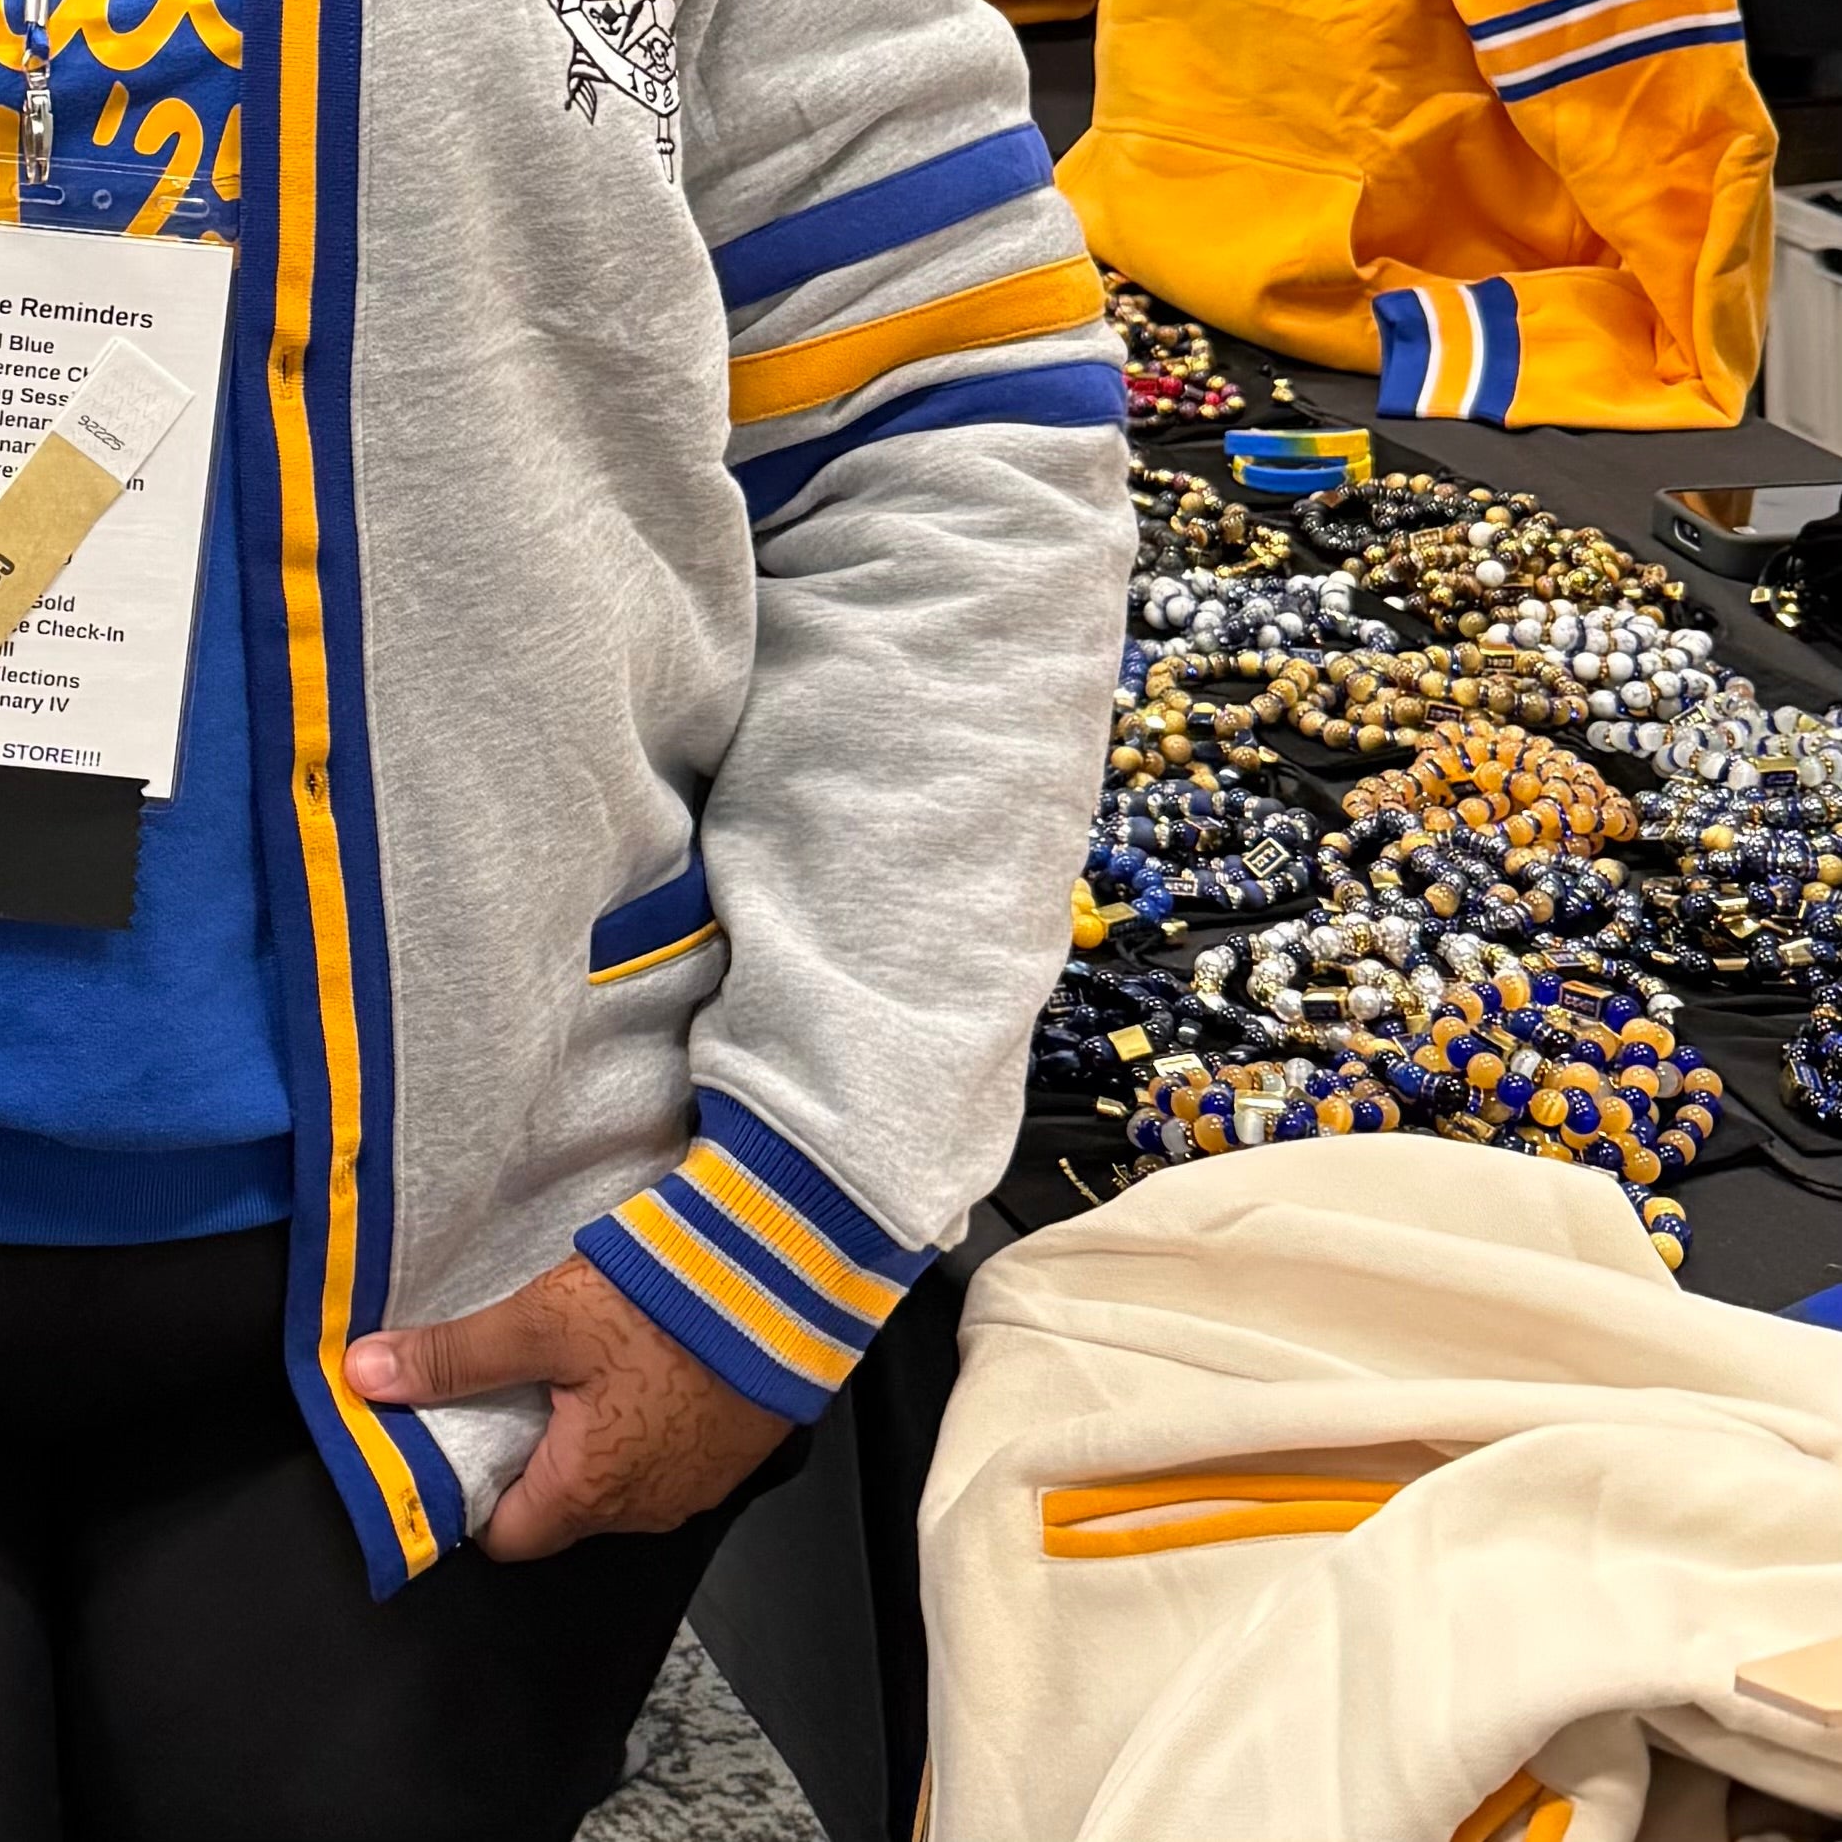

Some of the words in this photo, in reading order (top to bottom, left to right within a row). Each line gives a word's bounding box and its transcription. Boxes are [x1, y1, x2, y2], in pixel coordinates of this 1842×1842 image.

[627, 66, 674, 109] 192
[20, 297, 154, 329] Reminders
[9, 335, 55, 354] Blue
[20, 388, 75, 408] Sess
[78, 414, 126, 451] 92225
[36, 619, 125, 643] Check-In
[50, 696, 70, 713] IV
[2, 743, 102, 768] STORE!!!!
